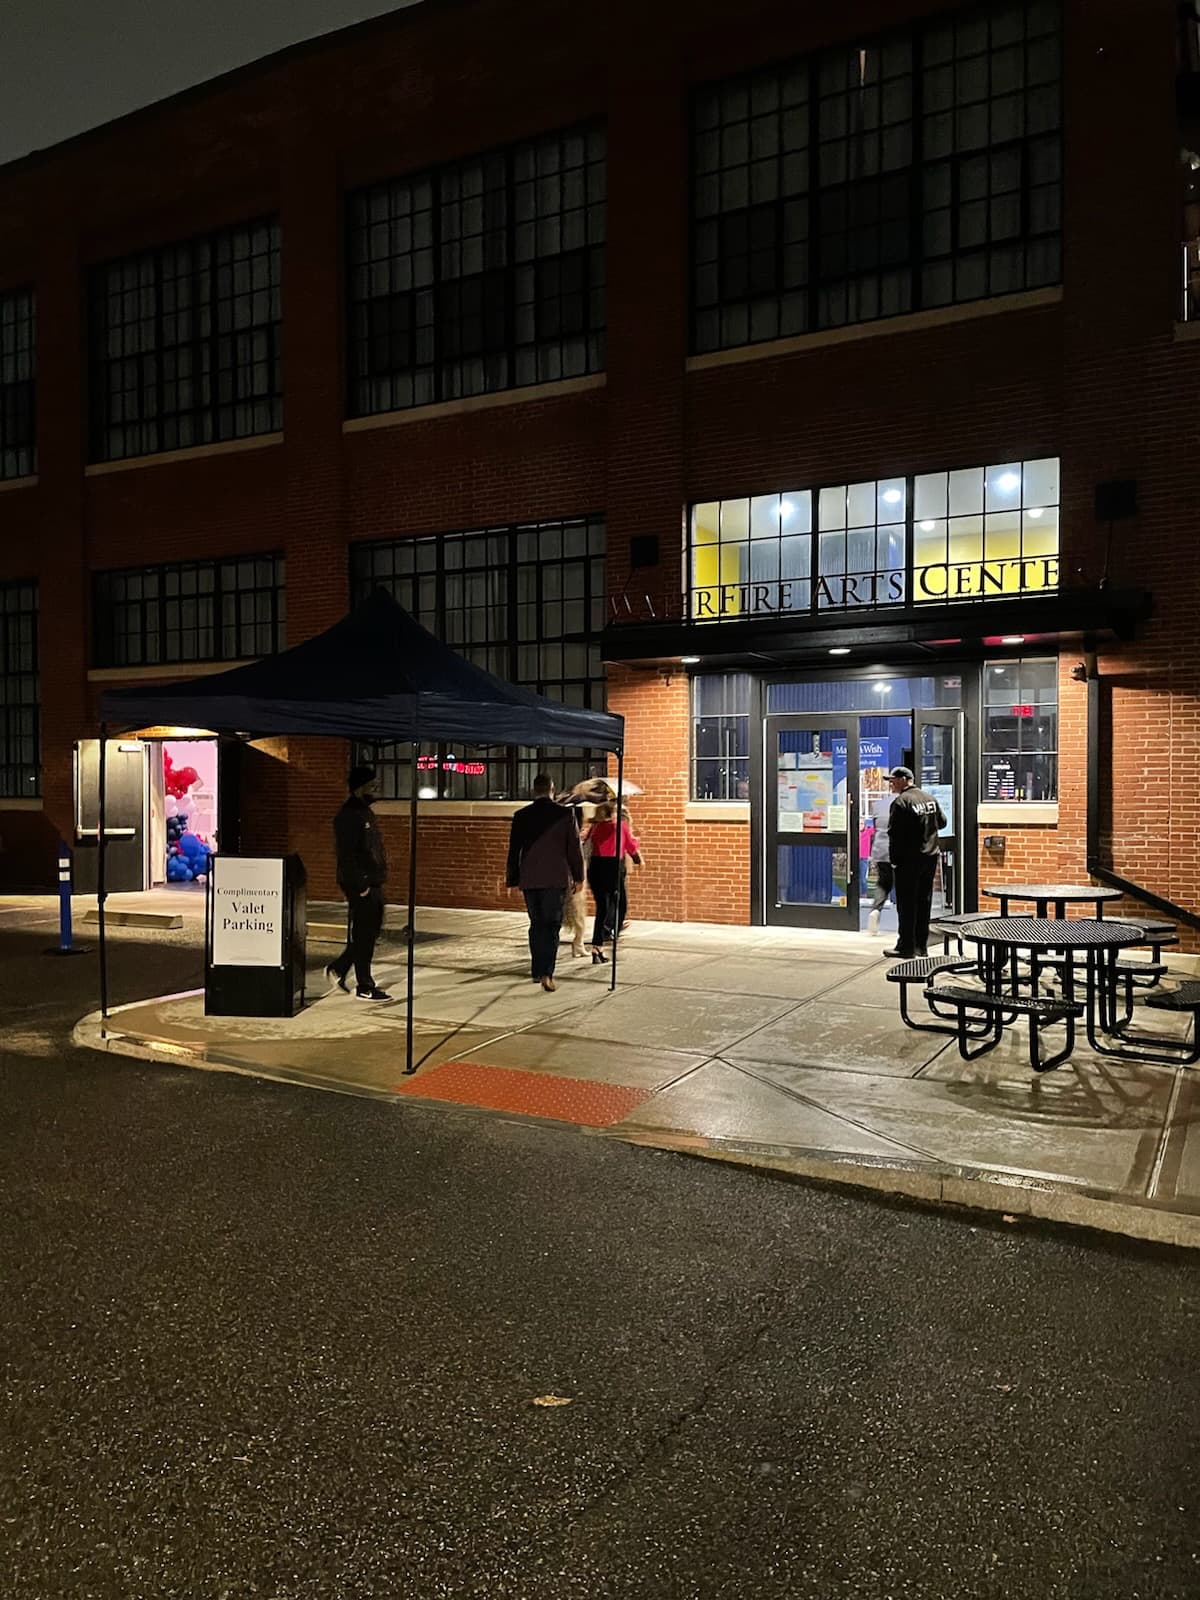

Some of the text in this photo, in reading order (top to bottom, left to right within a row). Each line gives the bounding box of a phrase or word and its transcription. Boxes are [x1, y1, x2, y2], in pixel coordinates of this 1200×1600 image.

[808, 572, 903, 606] ARTS
[912, 801, 937, 816] VALET
[217, 888, 279, 898] Complimentary
[232, 902, 264, 914] Valet
[223, 918, 274, 934] Parking
